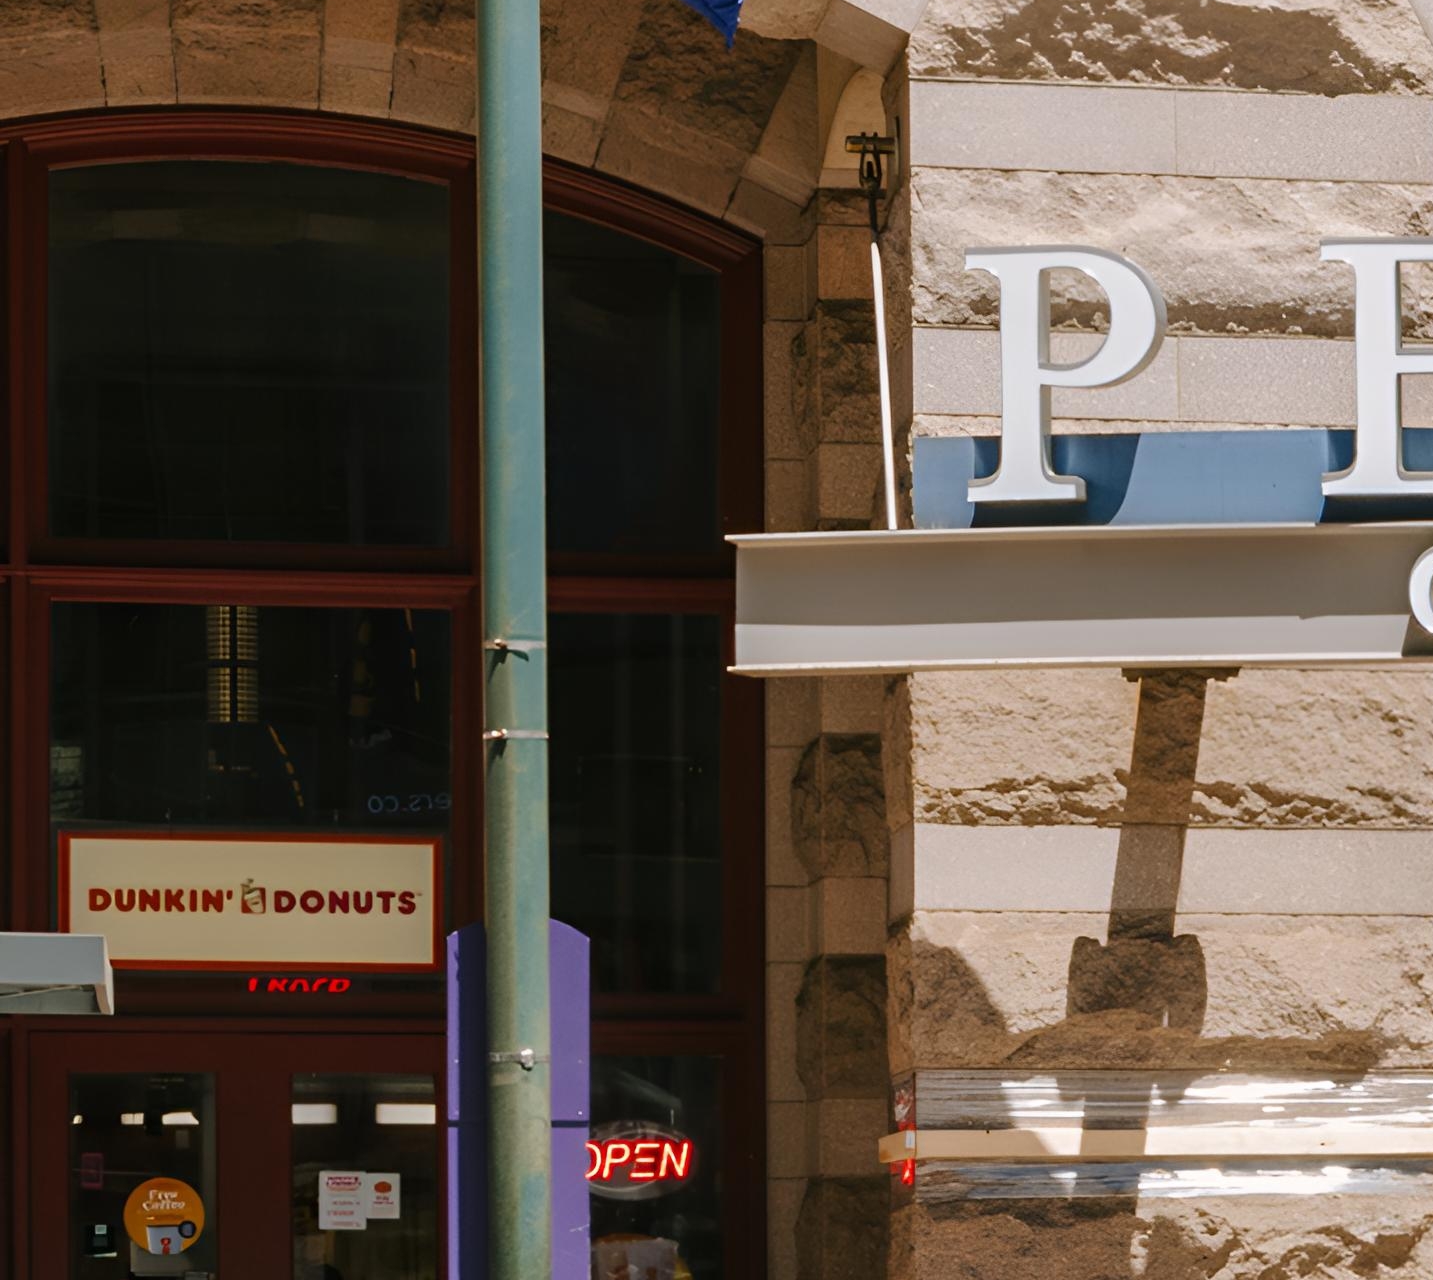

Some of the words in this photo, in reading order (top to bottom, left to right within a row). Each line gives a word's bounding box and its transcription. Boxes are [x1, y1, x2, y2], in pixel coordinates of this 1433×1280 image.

[88, 887, 234, 913] DUNKIN'
[273, 889, 418, 915] DONUTS
[584, 1140, 692, 1182] OPEN
